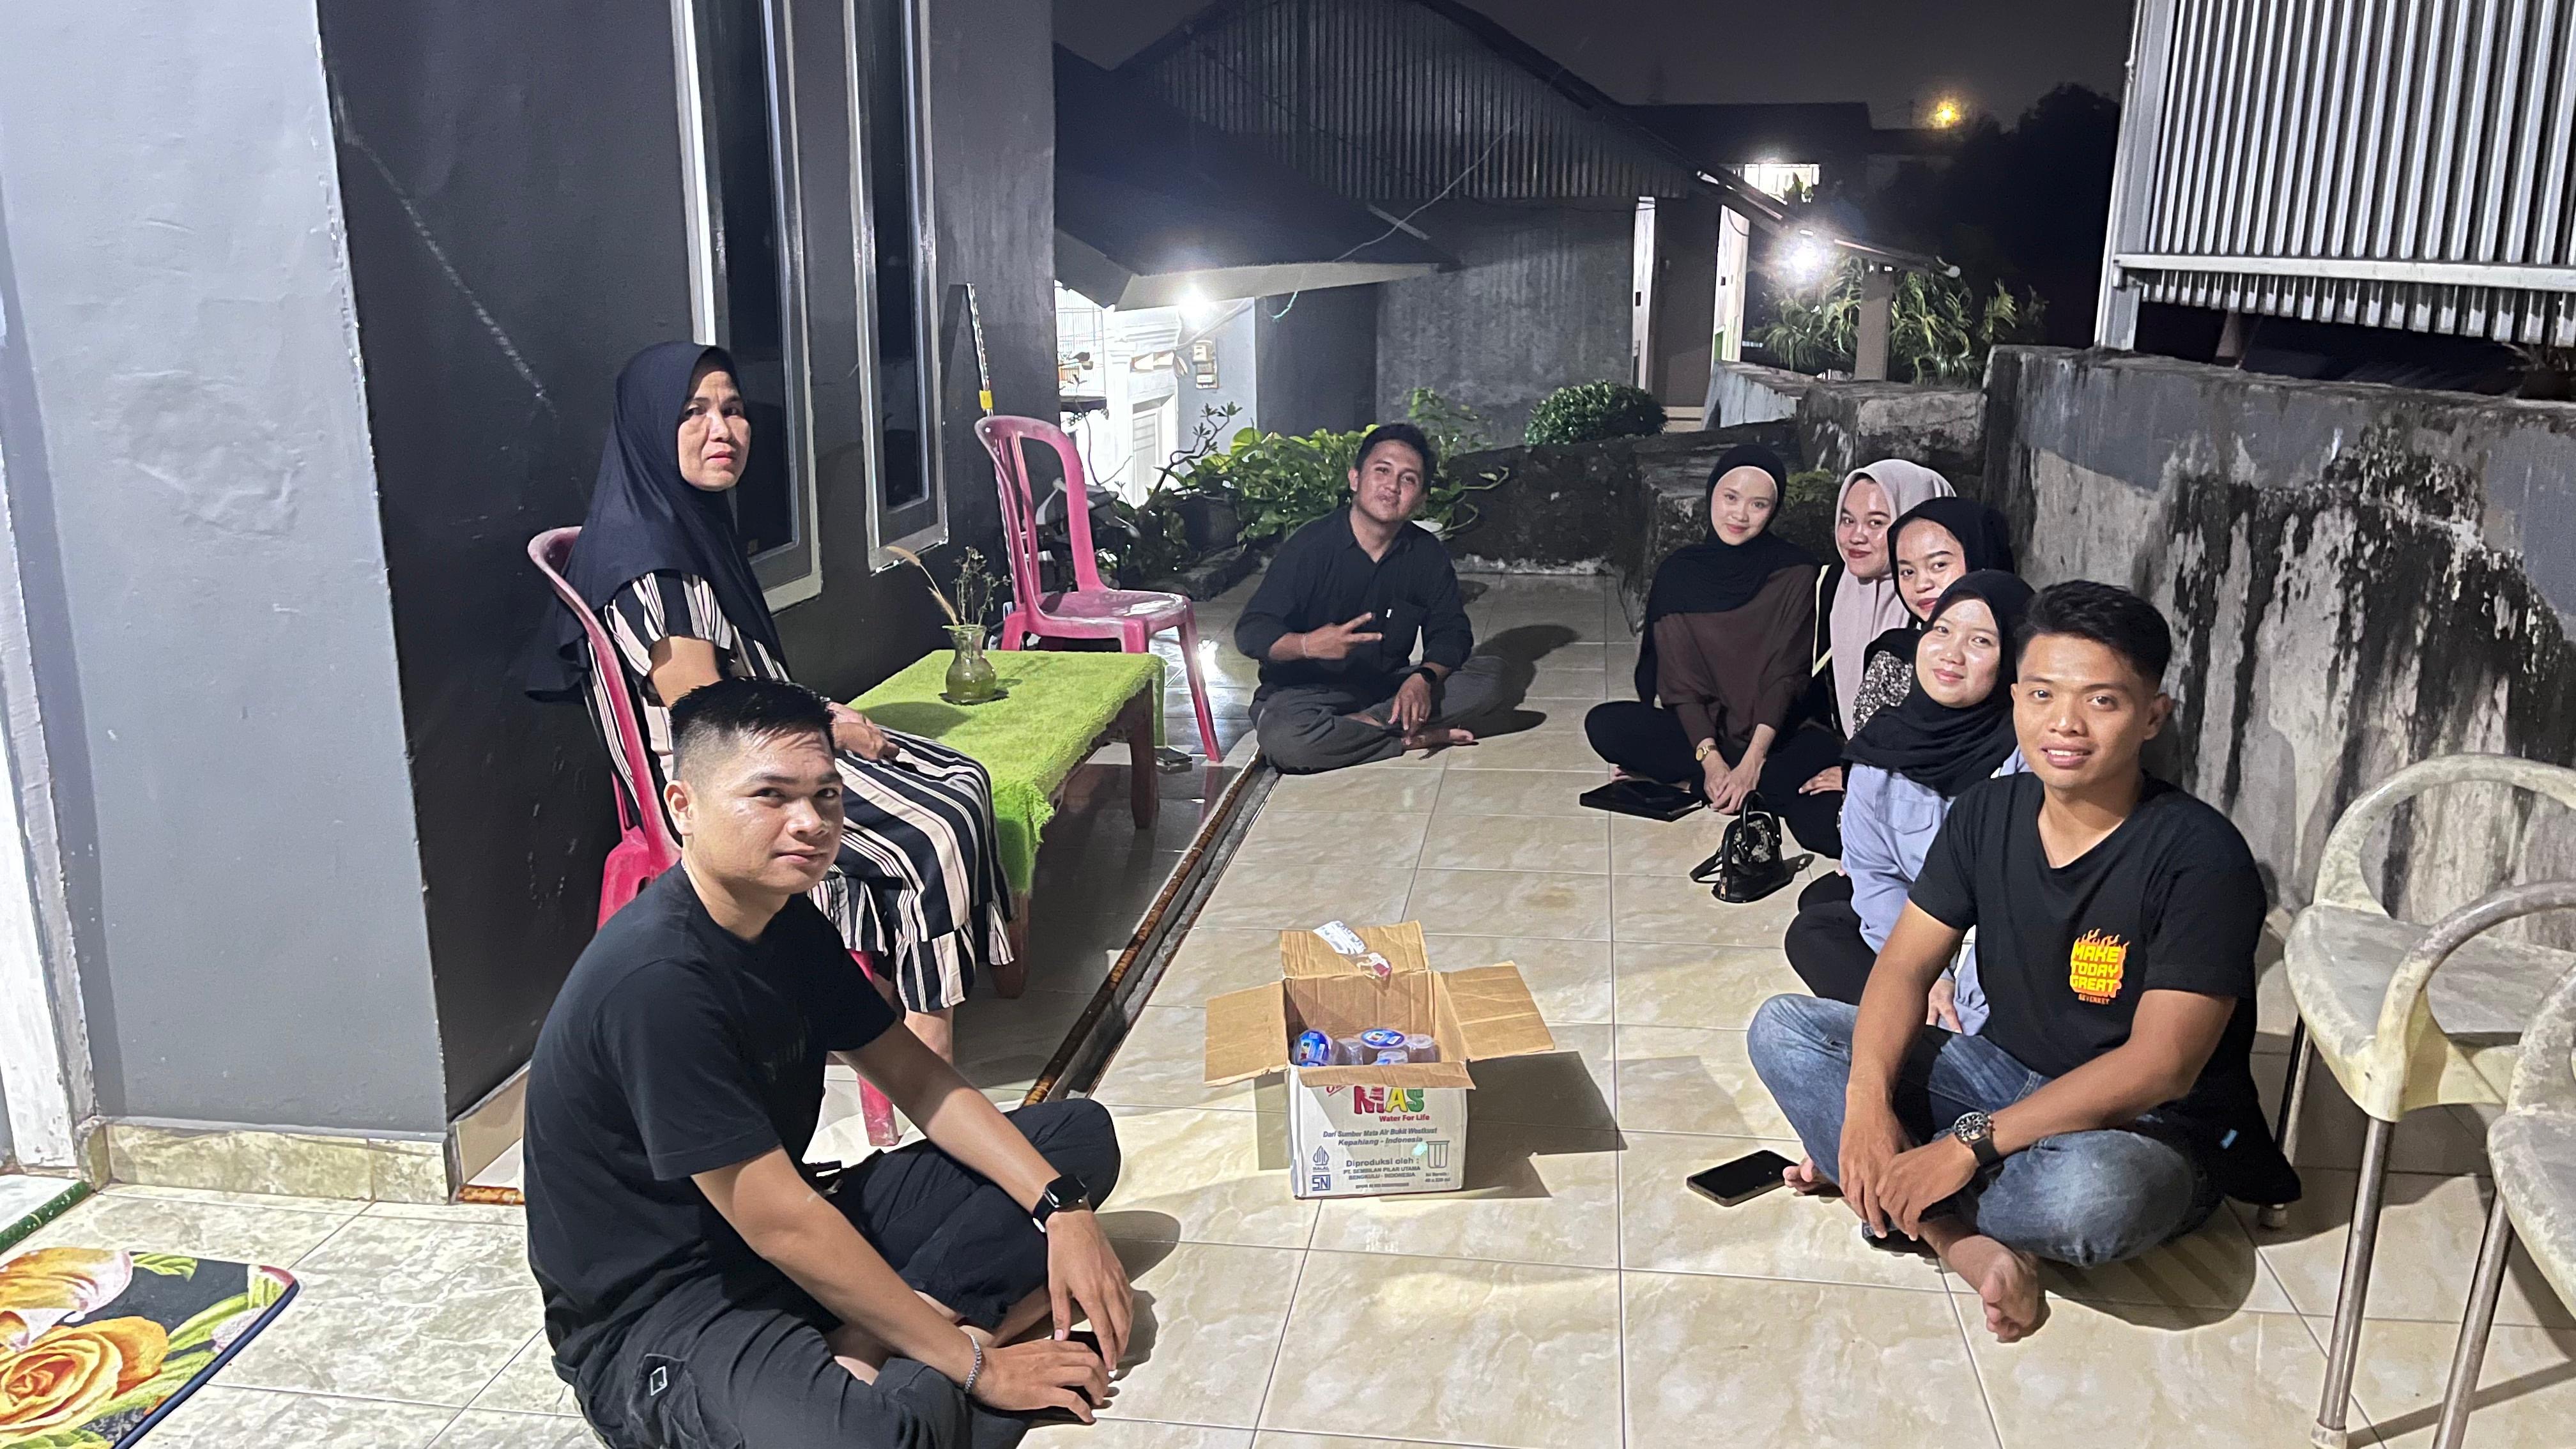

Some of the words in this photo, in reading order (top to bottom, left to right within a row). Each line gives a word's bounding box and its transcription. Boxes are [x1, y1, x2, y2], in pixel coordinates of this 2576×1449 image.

[2073, 944, 2121, 963] MAKE
[2071, 961, 2119, 977] TODAY
[2070, 975, 2118, 992] GREAT
[1338, 1138, 1379, 1147] Kepahiang
[1346, 1158, 1393, 1168] Diproduksi
